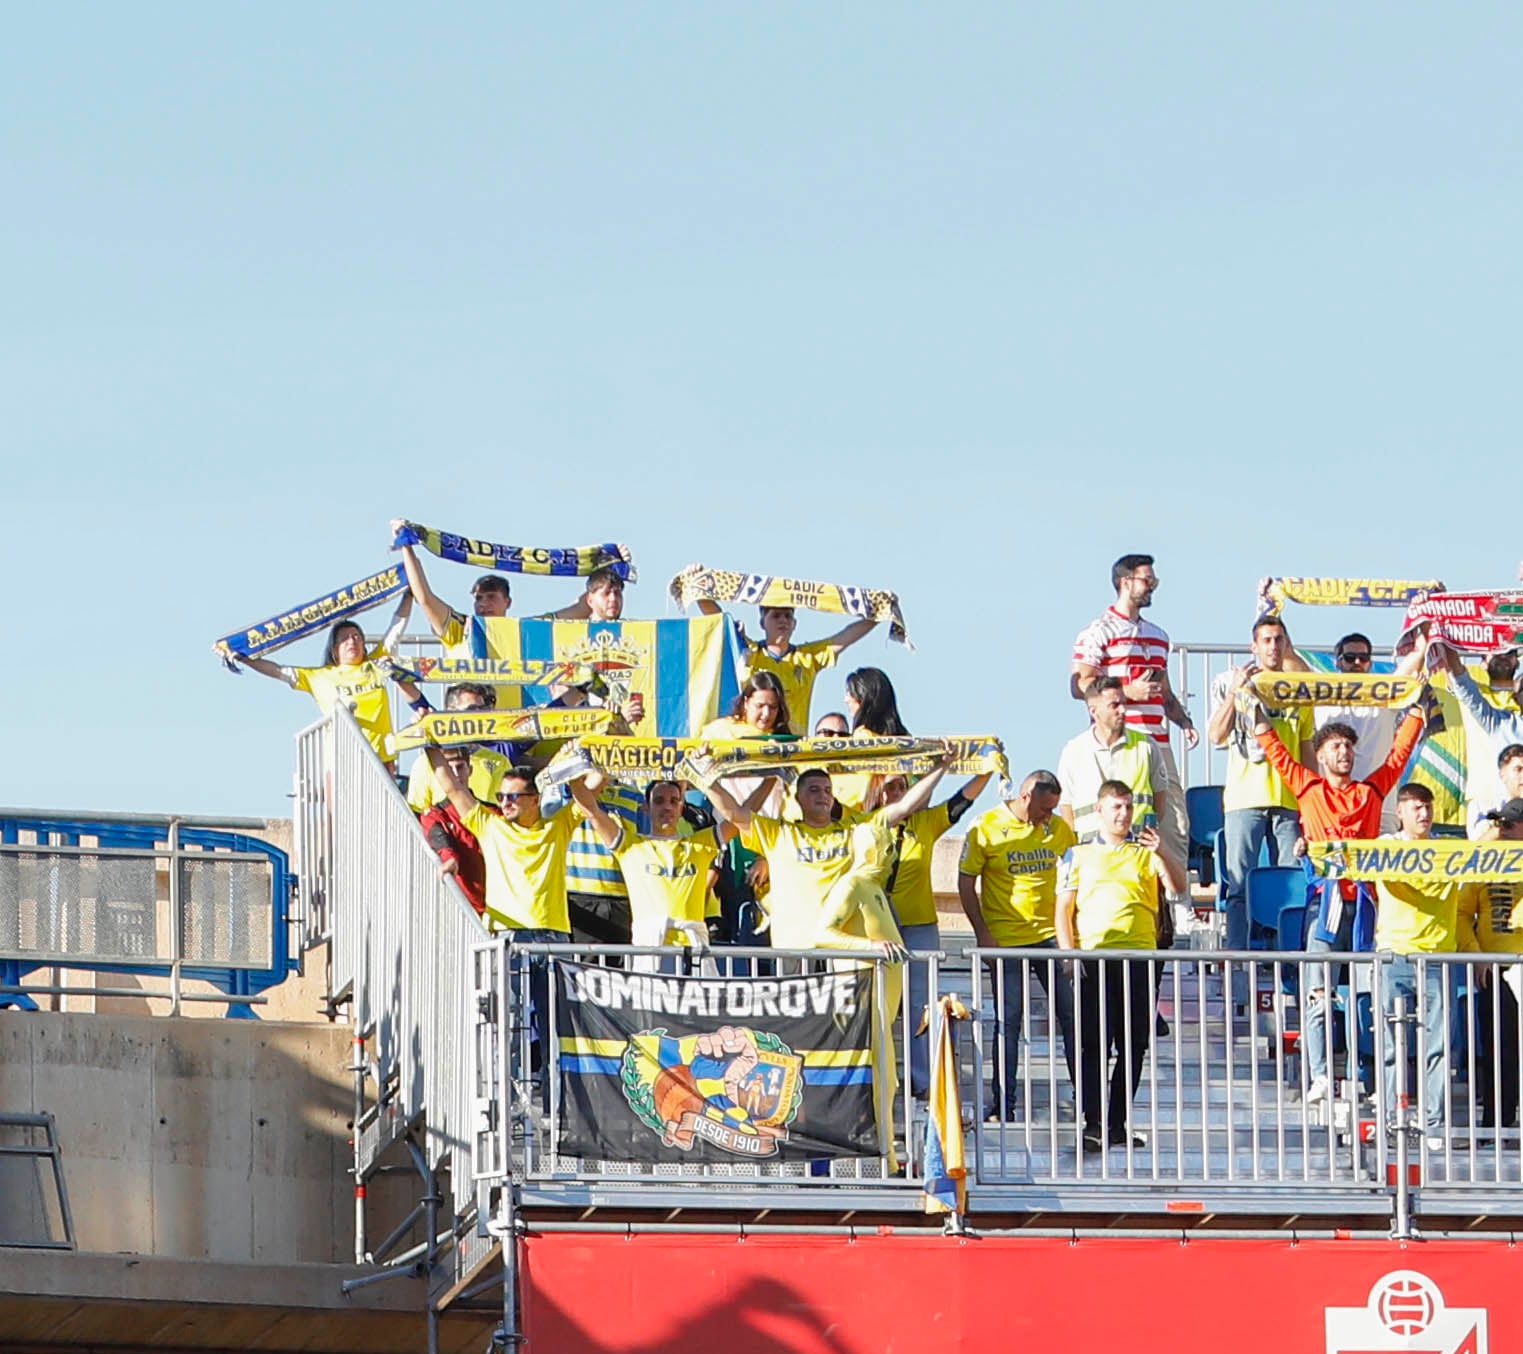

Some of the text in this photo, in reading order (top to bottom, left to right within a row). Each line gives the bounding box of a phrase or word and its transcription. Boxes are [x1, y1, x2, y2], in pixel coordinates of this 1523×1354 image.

[783, 578, 825, 595] CADIZ
[790, 594, 818, 608] 1910
[1273, 680, 1410, 703] CADIZ CF
[590, 741, 675, 768] MÁGICO
[1261, 993, 1271, 1008] 5
[693, 1116, 761, 1153] DESDE 1910
[1365, 1122, 1375, 1139] 2
